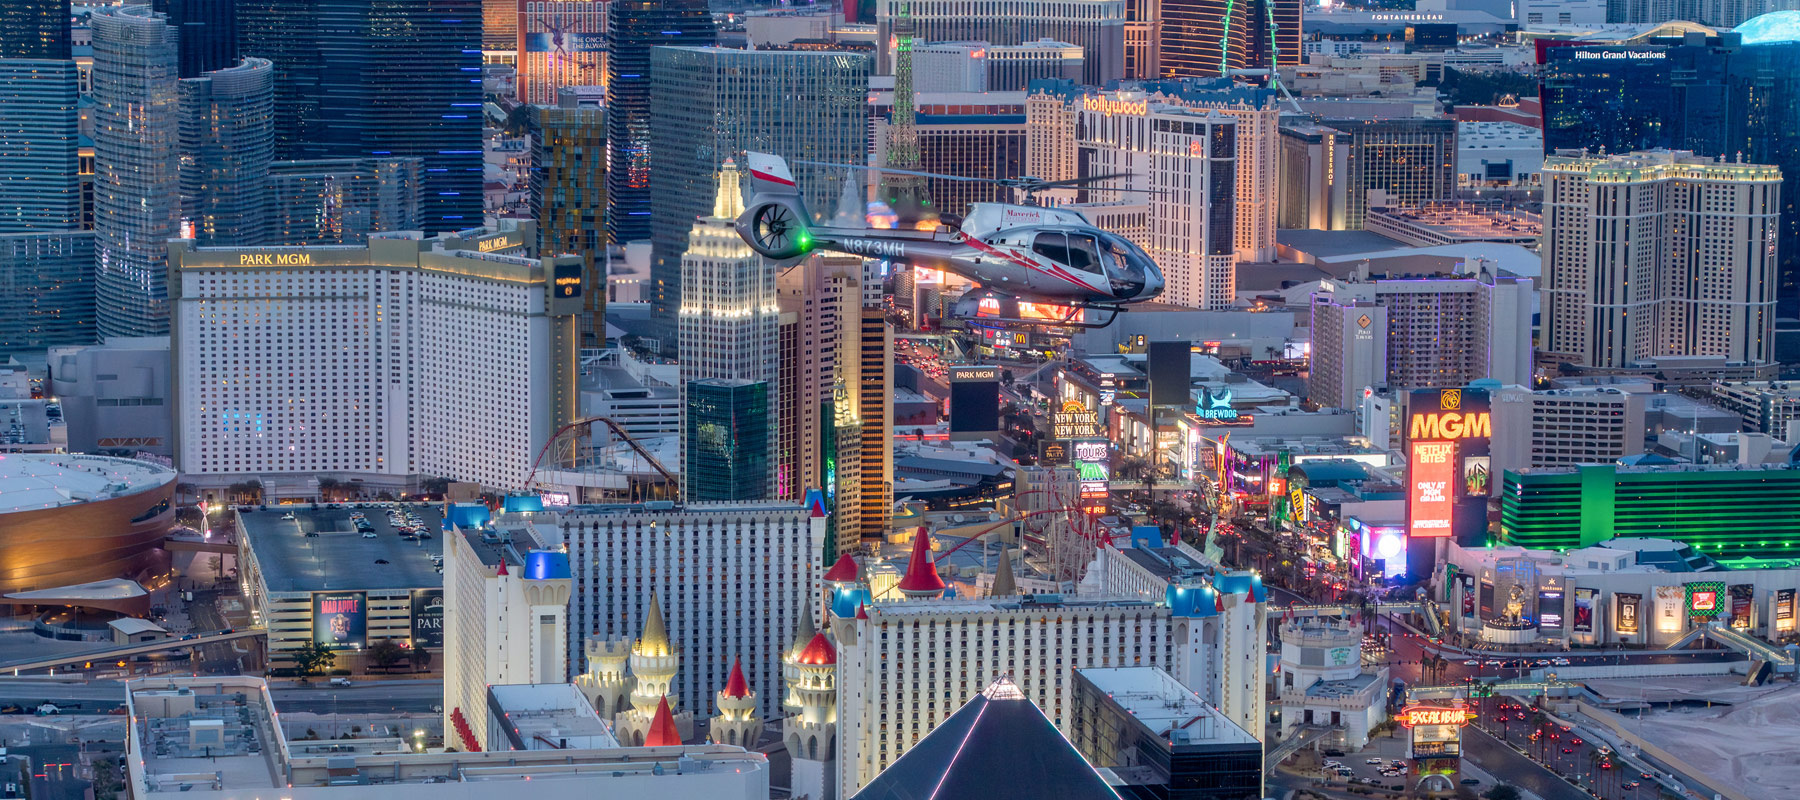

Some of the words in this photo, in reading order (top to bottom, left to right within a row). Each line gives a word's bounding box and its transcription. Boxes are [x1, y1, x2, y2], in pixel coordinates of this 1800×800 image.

[1575, 51, 1601, 59] Hilton
[1602, 51, 1627, 59] Grand
[1628, 51, 1666, 59] Vacations
[1083, 93, 1148, 117] hollywood
[1007, 209, 1040, 218] Maverick
[478, 239, 493, 252] PARK
[493, 236, 508, 248] MGM
[843, 239, 905, 256] N873MH
[240, 254, 273, 265] PARK
[276, 254, 310, 265] MGM
[1054, 413, 1074, 424] NEW
[1074, 413, 1097, 424] YORK
[1204, 409, 1237, 419] BREWDOG
[1054, 425, 1074, 435] NEW
[1074, 425, 1096, 435] YORK
[1410, 412, 1492, 439] MGM
[1077, 448, 1107, 459] TOURS
[1415, 444, 1452, 454] NETFLIX
[1420, 453, 1446, 463] BITES
[1417, 481, 1436, 490] ONLY
[1436, 481, 1446, 489] AT
[1423, 488, 1441, 496] MGM
[321, 600, 337, 614] MAD
[337, 599, 359, 613] APPLE
[417, 618, 444, 629] PAR
[1411, 710, 1466, 724] EXCALIBUR
